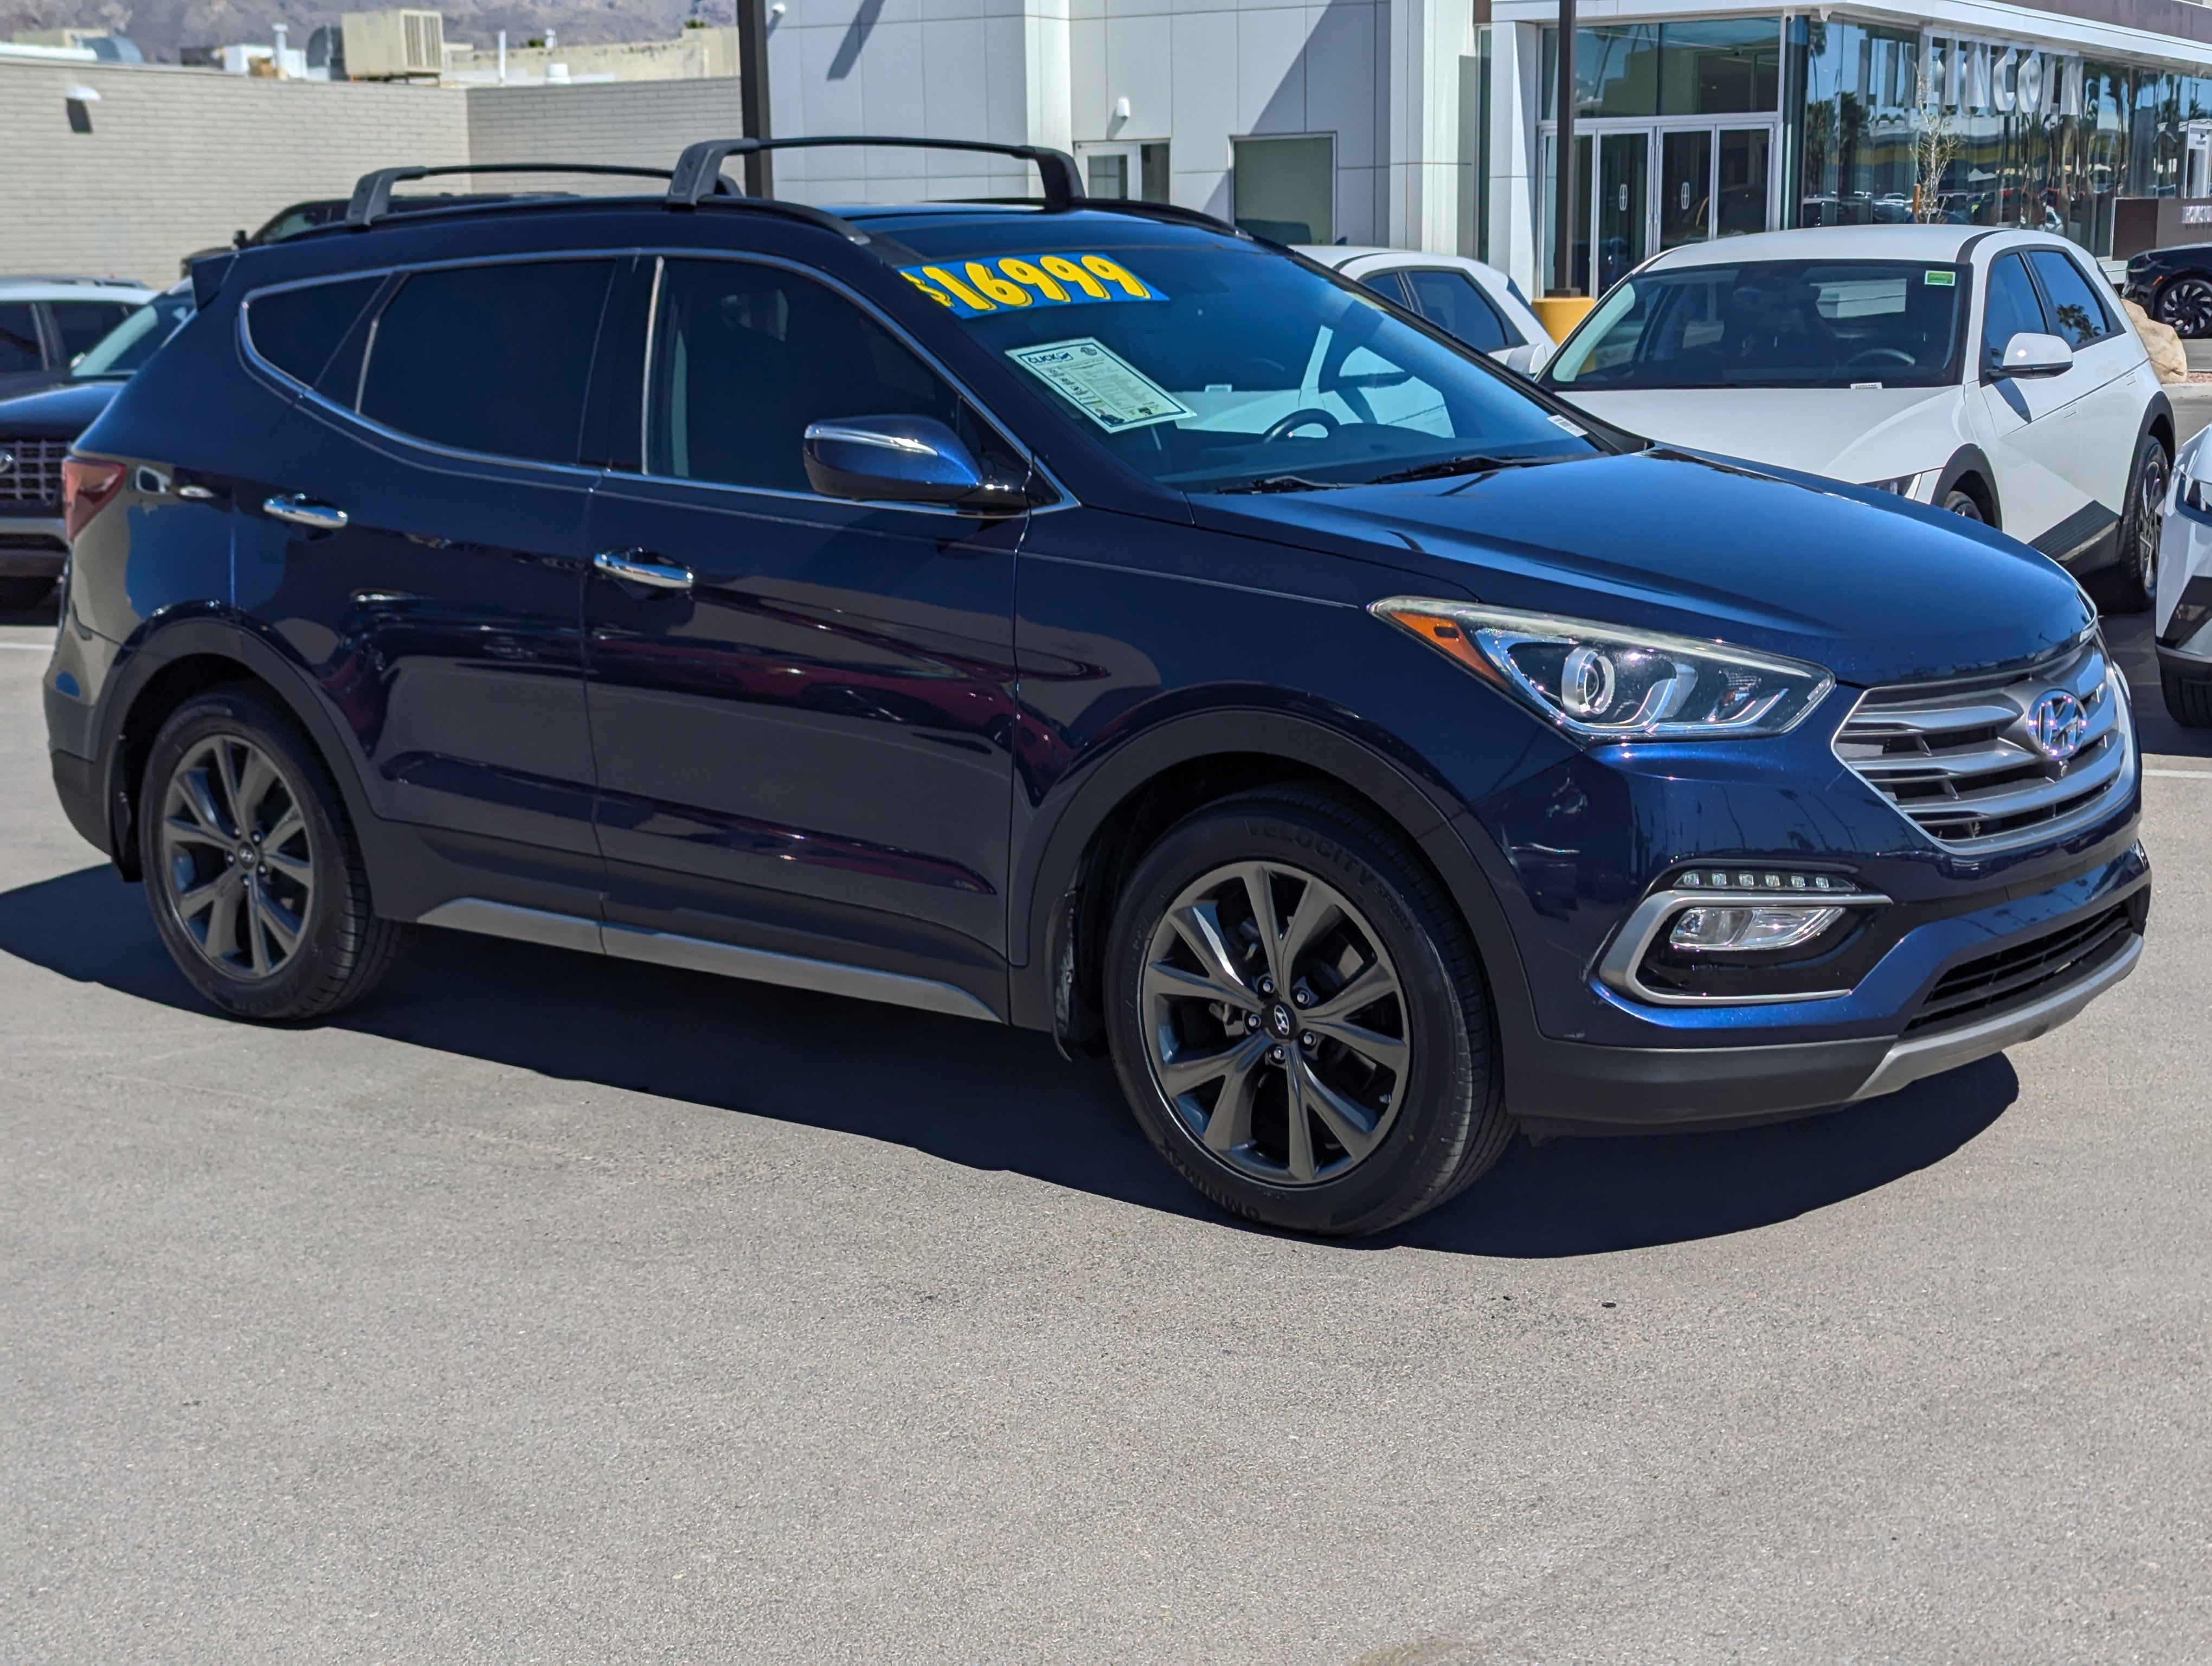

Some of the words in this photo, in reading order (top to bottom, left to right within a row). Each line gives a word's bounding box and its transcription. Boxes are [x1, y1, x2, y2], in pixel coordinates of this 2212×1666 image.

[1917, 35, 2084, 116] LINCOLN
[900, 255, 1150, 311] $16999
[1244, 818, 1377, 888] VELOCITY
[1374, 884, 1416, 932] SPORT
